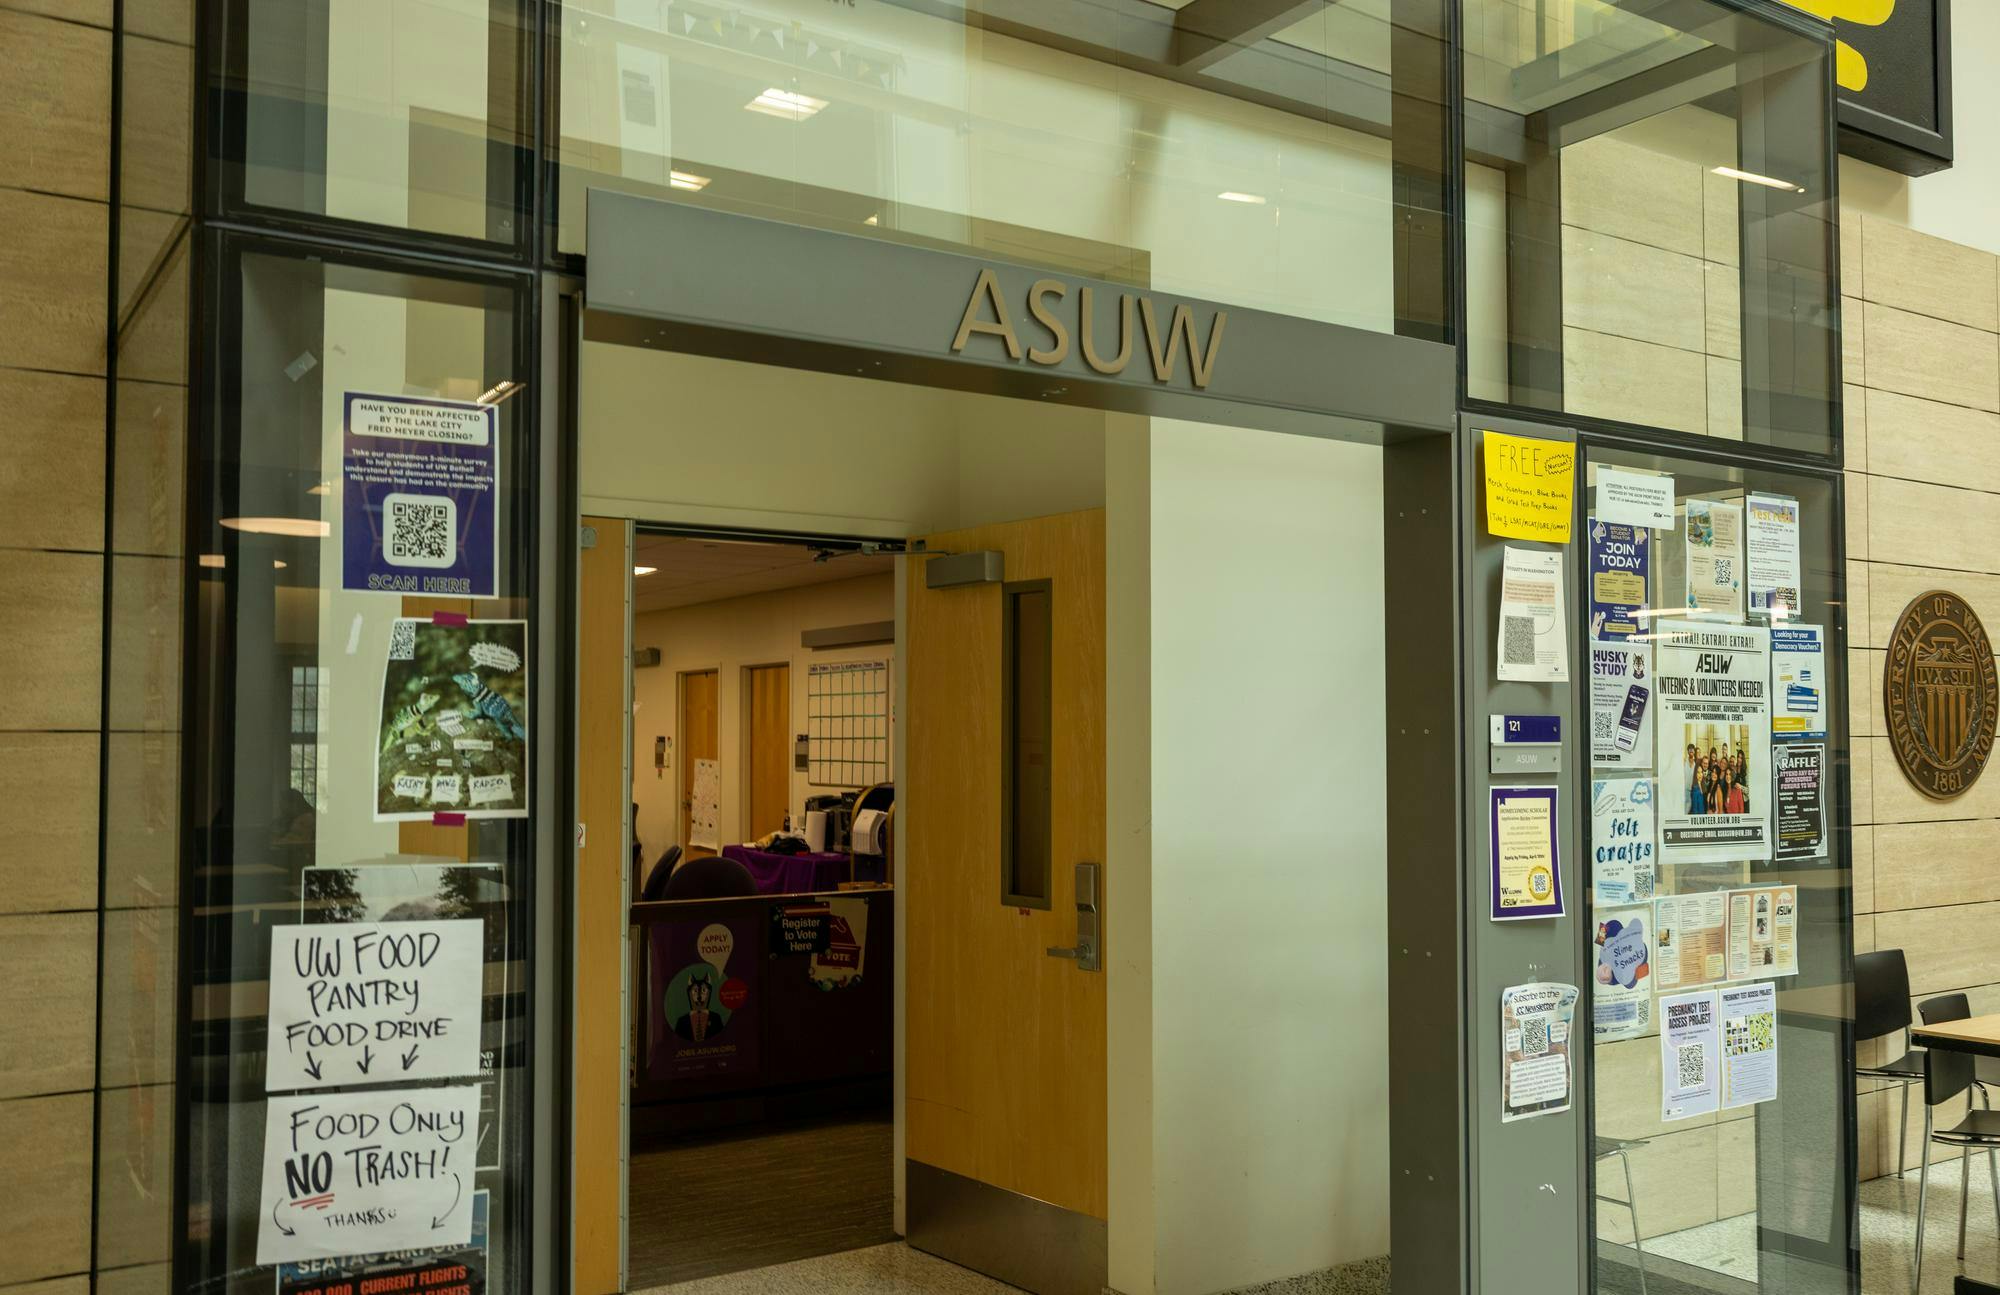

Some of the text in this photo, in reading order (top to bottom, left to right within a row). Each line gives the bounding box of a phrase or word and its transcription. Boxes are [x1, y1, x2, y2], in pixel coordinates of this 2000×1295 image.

[952, 268, 1227, 388] ASUW
[361, 404, 480, 422] HAVE YOU BEEN AFFECTED
[380, 415, 462, 429] BY THE LAKE CITY
[368, 424, 473, 440] FRED MEYER CLOSING?
[352, 448, 369, 456] Take
[386, 452, 428, 462] anonymous
[430, 455, 462, 464] 5-minute
[464, 458, 487, 467] survey
[1500, 444, 1543, 476] FREE
[375, 459, 392, 467] help
[394, 460, 424, 469] students
[450, 464, 475, 472] Bothell
[345, 466, 493, 483] understand and demonstrate the impacts
[448, 482, 488, 492] community
[1606, 542, 1634, 555] JOIN
[1600, 554, 1641, 569] TODAY
[368, 573, 471, 594] SCAN HERE
[1702, 633, 1727, 646] EXTRA!!
[1730, 636, 1754, 648] EXTRA!!
[1775, 631, 1792, 639] Looking
[1775, 643, 1797, 651] Democracy
[1594, 650, 1628, 663] HUSKY
[1696, 653, 1733, 674] ASUW
[1594, 663, 1627, 676] STUDY
[1660, 677, 1763, 698] INTERNS & VOLUNTEERS NEEDED!
[1890, 597, 1997, 772] UNIVERSITY OF WASHINGTON
[1508, 721, 1520, 731] 121
[1516, 754, 1538, 763] ASUW
[1781, 757, 1817, 769] RAFFLE
[1932, 770, 1964, 792] 1861
[1610, 818, 1638, 838] felt
[1691, 817, 1740, 825] VOLUNTEER.ASUW.ORG
[1596, 842, 1651, 864] crafts
[1776, 905, 1793, 916] ASUW
[781, 917, 821, 930] Register
[703, 934, 728, 943] APPLY
[785, 929, 817, 941] to Vote
[701, 945, 730, 954] TODAY!
[790, 941, 812, 952] Here
[1614, 944, 1632, 958] Slime
[295, 931, 440, 978] UW FOOD
[826, 952, 851, 962] VOTE
[1620, 950, 1644, 969] Snacks
[307, 979, 420, 1017] PANTRY
[1514, 992, 1538, 1003] Subscribe
[1525, 1003, 1556, 1014] Newsletter
[1668, 1001, 1710, 1017] PREGNANCY TEST
[1669, 1013, 1711, 1029] ACCESS PROJECT
[286, 1018, 453, 1053] FOOD DRIVE
[290, 1102, 464, 1153] FOOD ONLY
[284, 1145, 450, 1199] NO TRASH!
[360, 1273, 416, 1295] CURRENT
[419, 1265, 467, 1286] FLIGHTS
